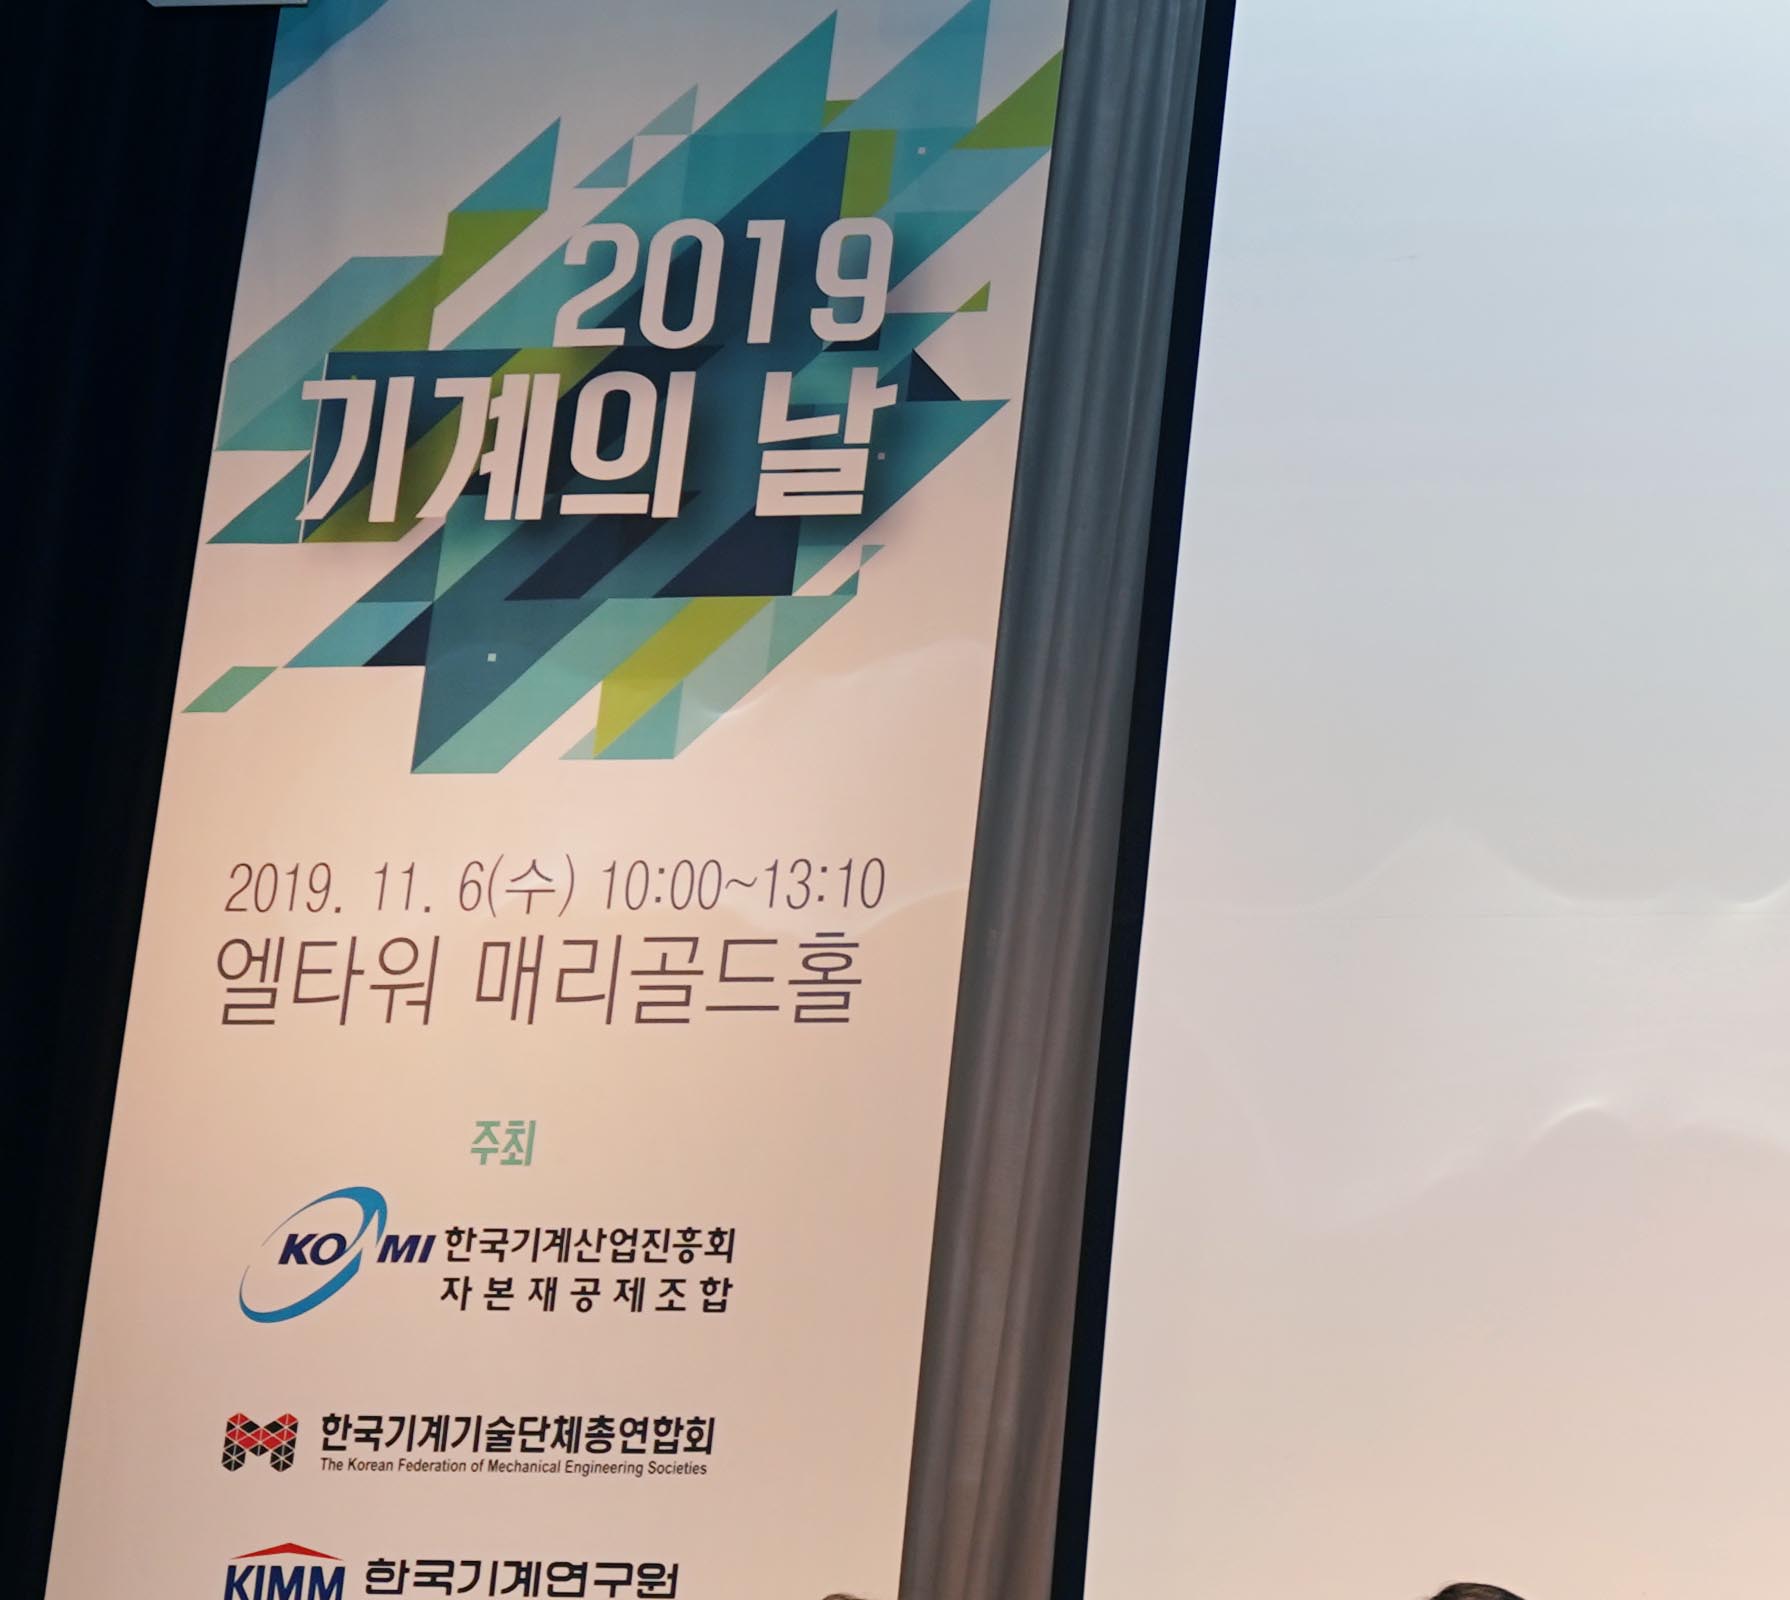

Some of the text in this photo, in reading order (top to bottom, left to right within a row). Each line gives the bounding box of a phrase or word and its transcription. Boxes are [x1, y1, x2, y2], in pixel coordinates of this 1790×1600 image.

[553, 217, 895, 348] 2019
[296, 366, 898, 523] 기계의 날
[224, 854, 886, 918] 2019. 11. 6(수) 10:00~13:10
[216, 931, 862, 1027] 엘타워 매리골드홀
[470, 1120, 537, 1166] 주최
[444, 1226, 736, 1264] 한국기계산업진흥회
[321, 1413, 716, 1455] 한국기계기술단체총연합회
[321, 1457, 707, 1478] The Korean Federation of Mechanical Engineering Societies
[365, 1558, 679, 1599] 한국기계연구원
